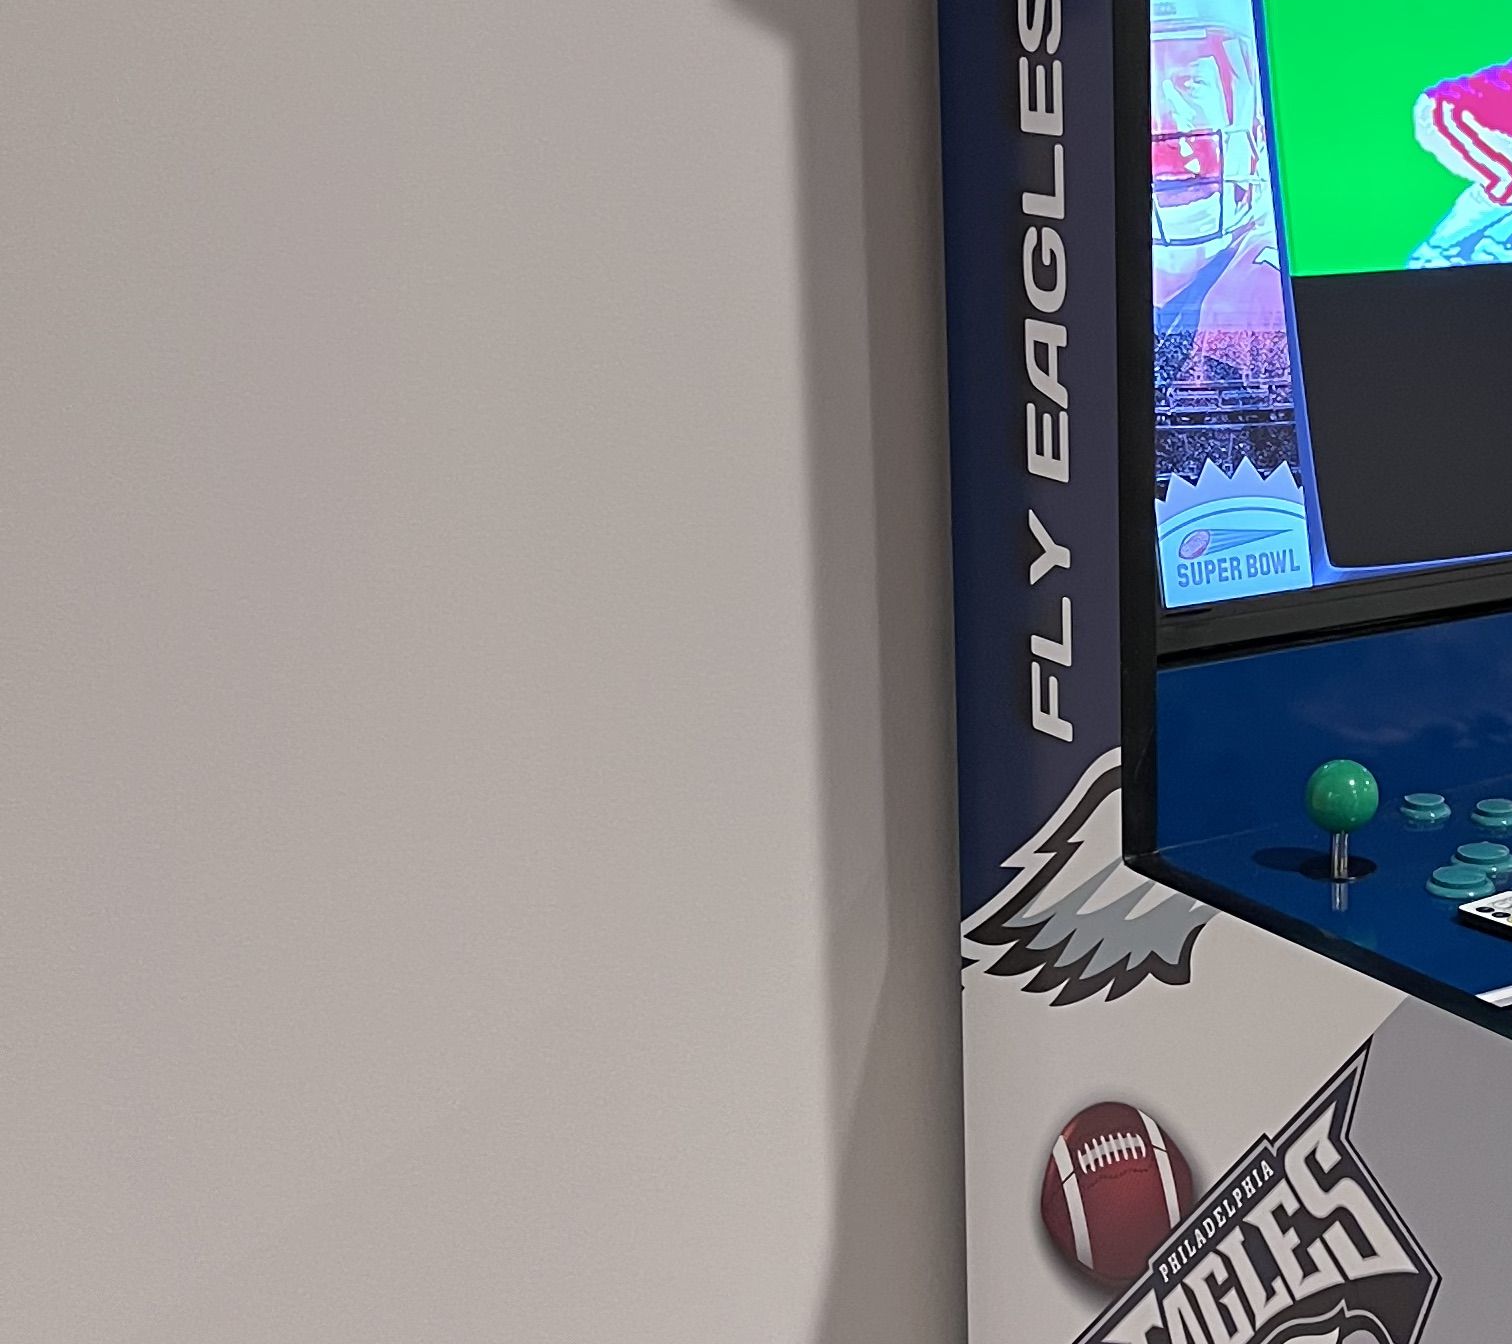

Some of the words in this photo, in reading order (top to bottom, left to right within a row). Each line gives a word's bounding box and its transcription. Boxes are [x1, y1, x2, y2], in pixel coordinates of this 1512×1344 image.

[1027, 508, 1074, 743] FLY
[1176, 557, 1243, 589] SUPER
[1246, 548, 1301, 578] BOWL
[1158, 1159, 1275, 1284] PHILADELPHIA
